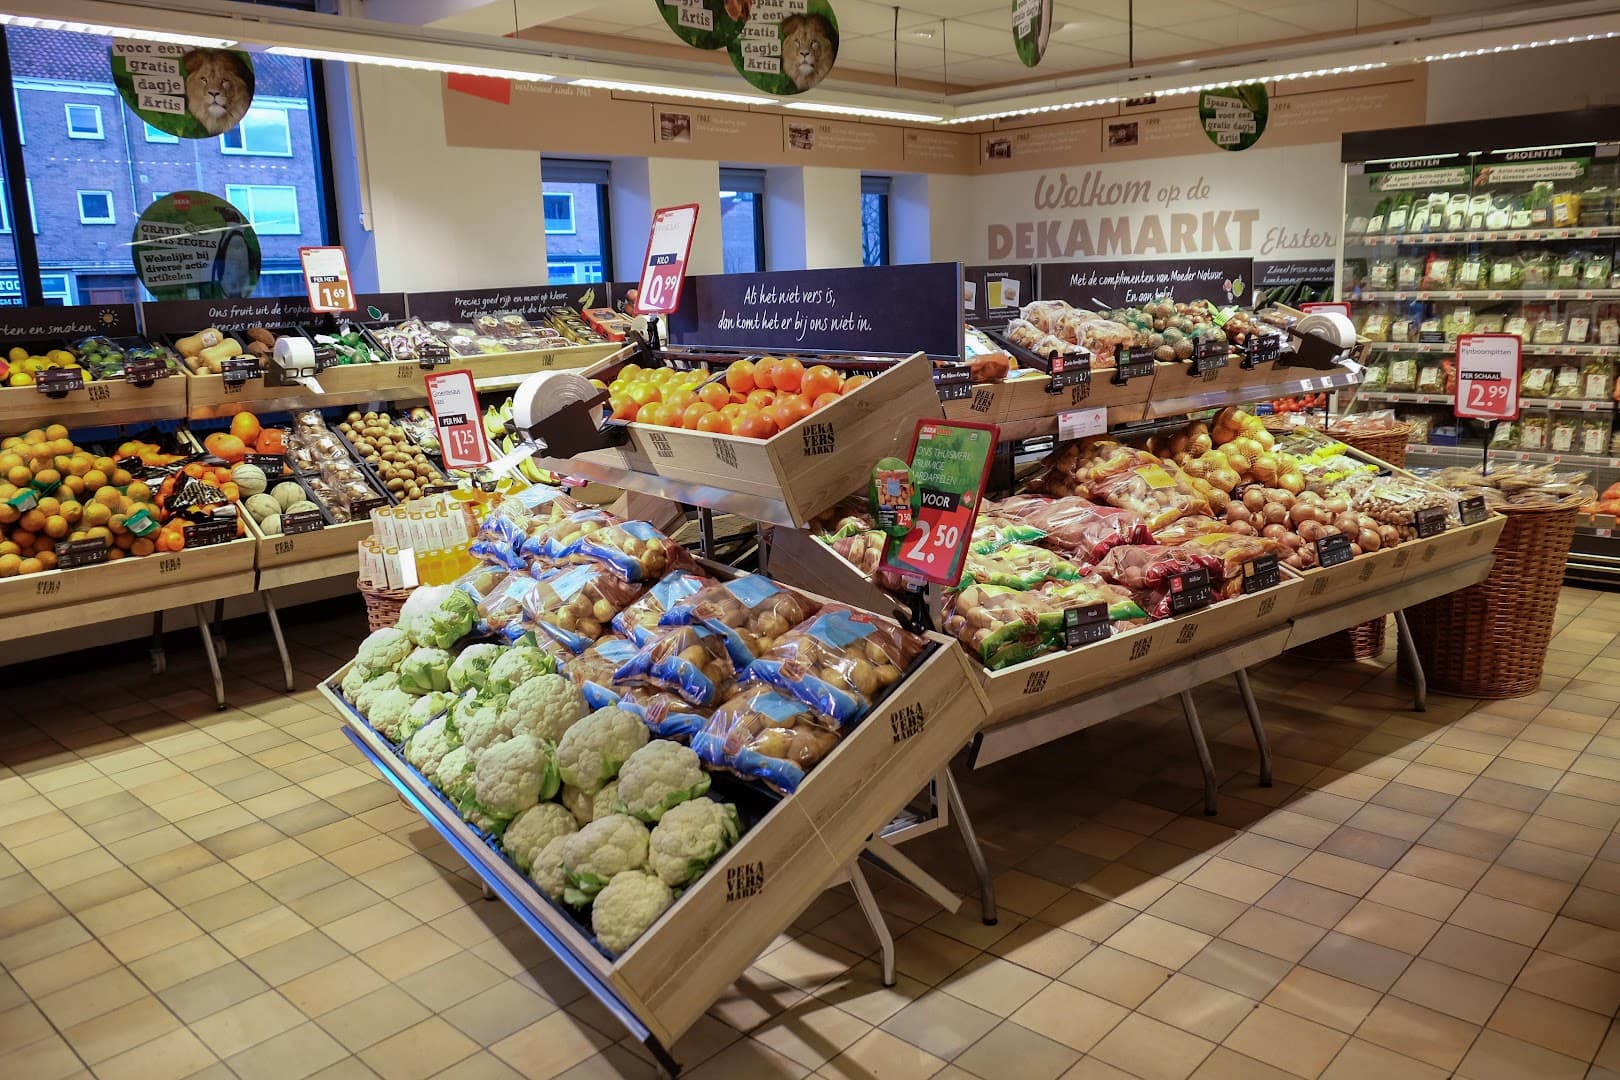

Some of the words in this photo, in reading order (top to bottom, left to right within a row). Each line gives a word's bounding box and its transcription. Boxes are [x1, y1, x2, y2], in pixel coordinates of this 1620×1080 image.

[681, 8, 710, 26] Artis
[762, 11, 785, 21] een
[740, 26, 776, 39] gratis
[116, 43, 152, 54] voor
[158, 44, 185, 55] een
[744, 43, 779, 57] dagje
[129, 59, 176, 74] gratis
[747, 58, 777, 72] Artis
[137, 78, 182, 95] dagje
[142, 95, 182, 112] Artis
[1206, 97, 1229, 109] Spaar
[1217, 112, 1236, 120] voor
[1207, 120, 1231, 130] gratis
[1219, 134, 1240, 143] Artis
[1505, 149, 1563, 161] GROENTEN
[1389, 159, 1440, 170] GROENTEN
[1035, 170, 1152, 210] Welkom
[1157, 186, 1180, 208] op
[1187, 176, 1211, 201] de
[141, 224, 182, 235] GRATIS
[987, 208, 1260, 261] DEKAMARKT
[143, 252, 194, 265] Wekelijks
[196, 250, 209, 261] bij
[656, 256, 670, 265] KILO
[145, 263, 183, 274] diverse
[185, 261, 208, 271] actie
[148, 272, 193, 284] artikelen
[1070, 273, 1088, 287] Met
[1088, 270, 1099, 286] de
[1099, 269, 1156, 290] complimenten
[1155, 273, 1170, 283] van
[1171, 266, 1197, 282] Moeder
[1196, 267, 1224, 281] Natuur.
[322, 287, 346, 307] 1.69
[454, 297, 481, 307] Precies
[482, 294, 500, 310] goed
[499, 295, 512, 308] rijp
[523, 294, 540, 302] mooi
[540, 293, 549, 304] op
[549, 290, 569, 301] kleur.
[743, 285, 758, 305] Als
[760, 283, 778, 305] het
[778, 284, 801, 305] niet
[801, 286, 823, 304] vers
[825, 286, 837, 309] is,
[1125, 289, 1138, 303] En
[1138, 291, 1154, 302] aan
[208, 307, 228, 318] Ons
[230, 304, 254, 318] fruit
[255, 304, 270, 315] uit
[270, 302, 282, 315] de
[28, 326, 47, 335] en
[47, 322, 97, 335] smoken.
[717, 309, 736, 330] dan
[736, 309, 761, 331] komt
[761, 308, 781, 331] het
[781, 316, 793, 330] er
[794, 310, 808, 342] bij
[809, 316, 828, 331] ons
[830, 309, 856, 331] niet
[856, 314, 873, 331] in.
[1461, 347, 1512, 356] Pijnboompitten
[1461, 372, 1474, 380] PER
[1470, 383, 1508, 407] 2.99
[443, 418, 454, 426] PER
[453, 416, 464, 425] PAK
[649, 432, 667, 441] DEKA
[802, 422, 834, 437] DEKA
[452, 430, 475, 456] 1.25
[653, 441, 672, 451] VERS
[803, 432, 835, 448] VERS
[804, 444, 834, 457] MARKT
[917, 446, 933, 457] ONS
[934, 448, 972, 461] THUISMERK
[922, 492, 950, 508] VOOR
[906, 521, 959, 564] 2.50
[890, 702, 923, 724] DEKA
[891, 712, 925, 736] VERS
[893, 726, 924, 744] MARKT
[727, 861, 764, 881] DEKA
[726, 873, 764, 892] VERS
